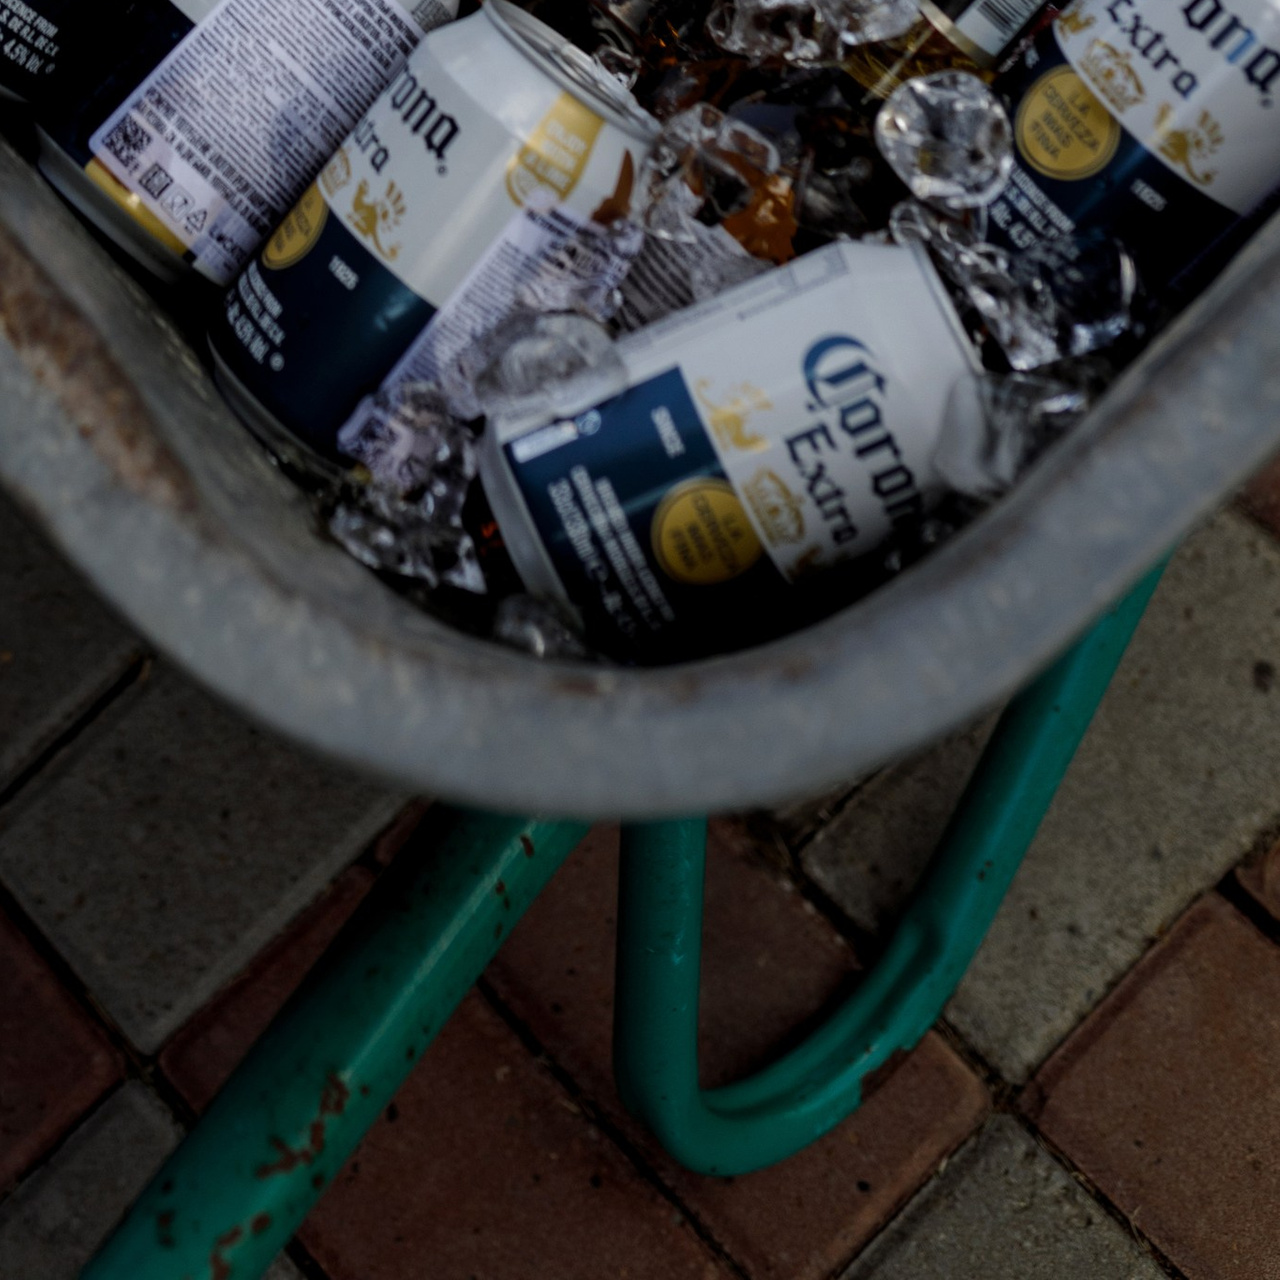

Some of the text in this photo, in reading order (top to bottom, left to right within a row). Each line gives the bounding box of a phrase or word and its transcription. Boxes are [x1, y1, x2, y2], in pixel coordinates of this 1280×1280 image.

[0, 35, 31, 67] 4.5%
[785, 419, 862, 543] Extra
[801, 333, 921, 528] Coron
